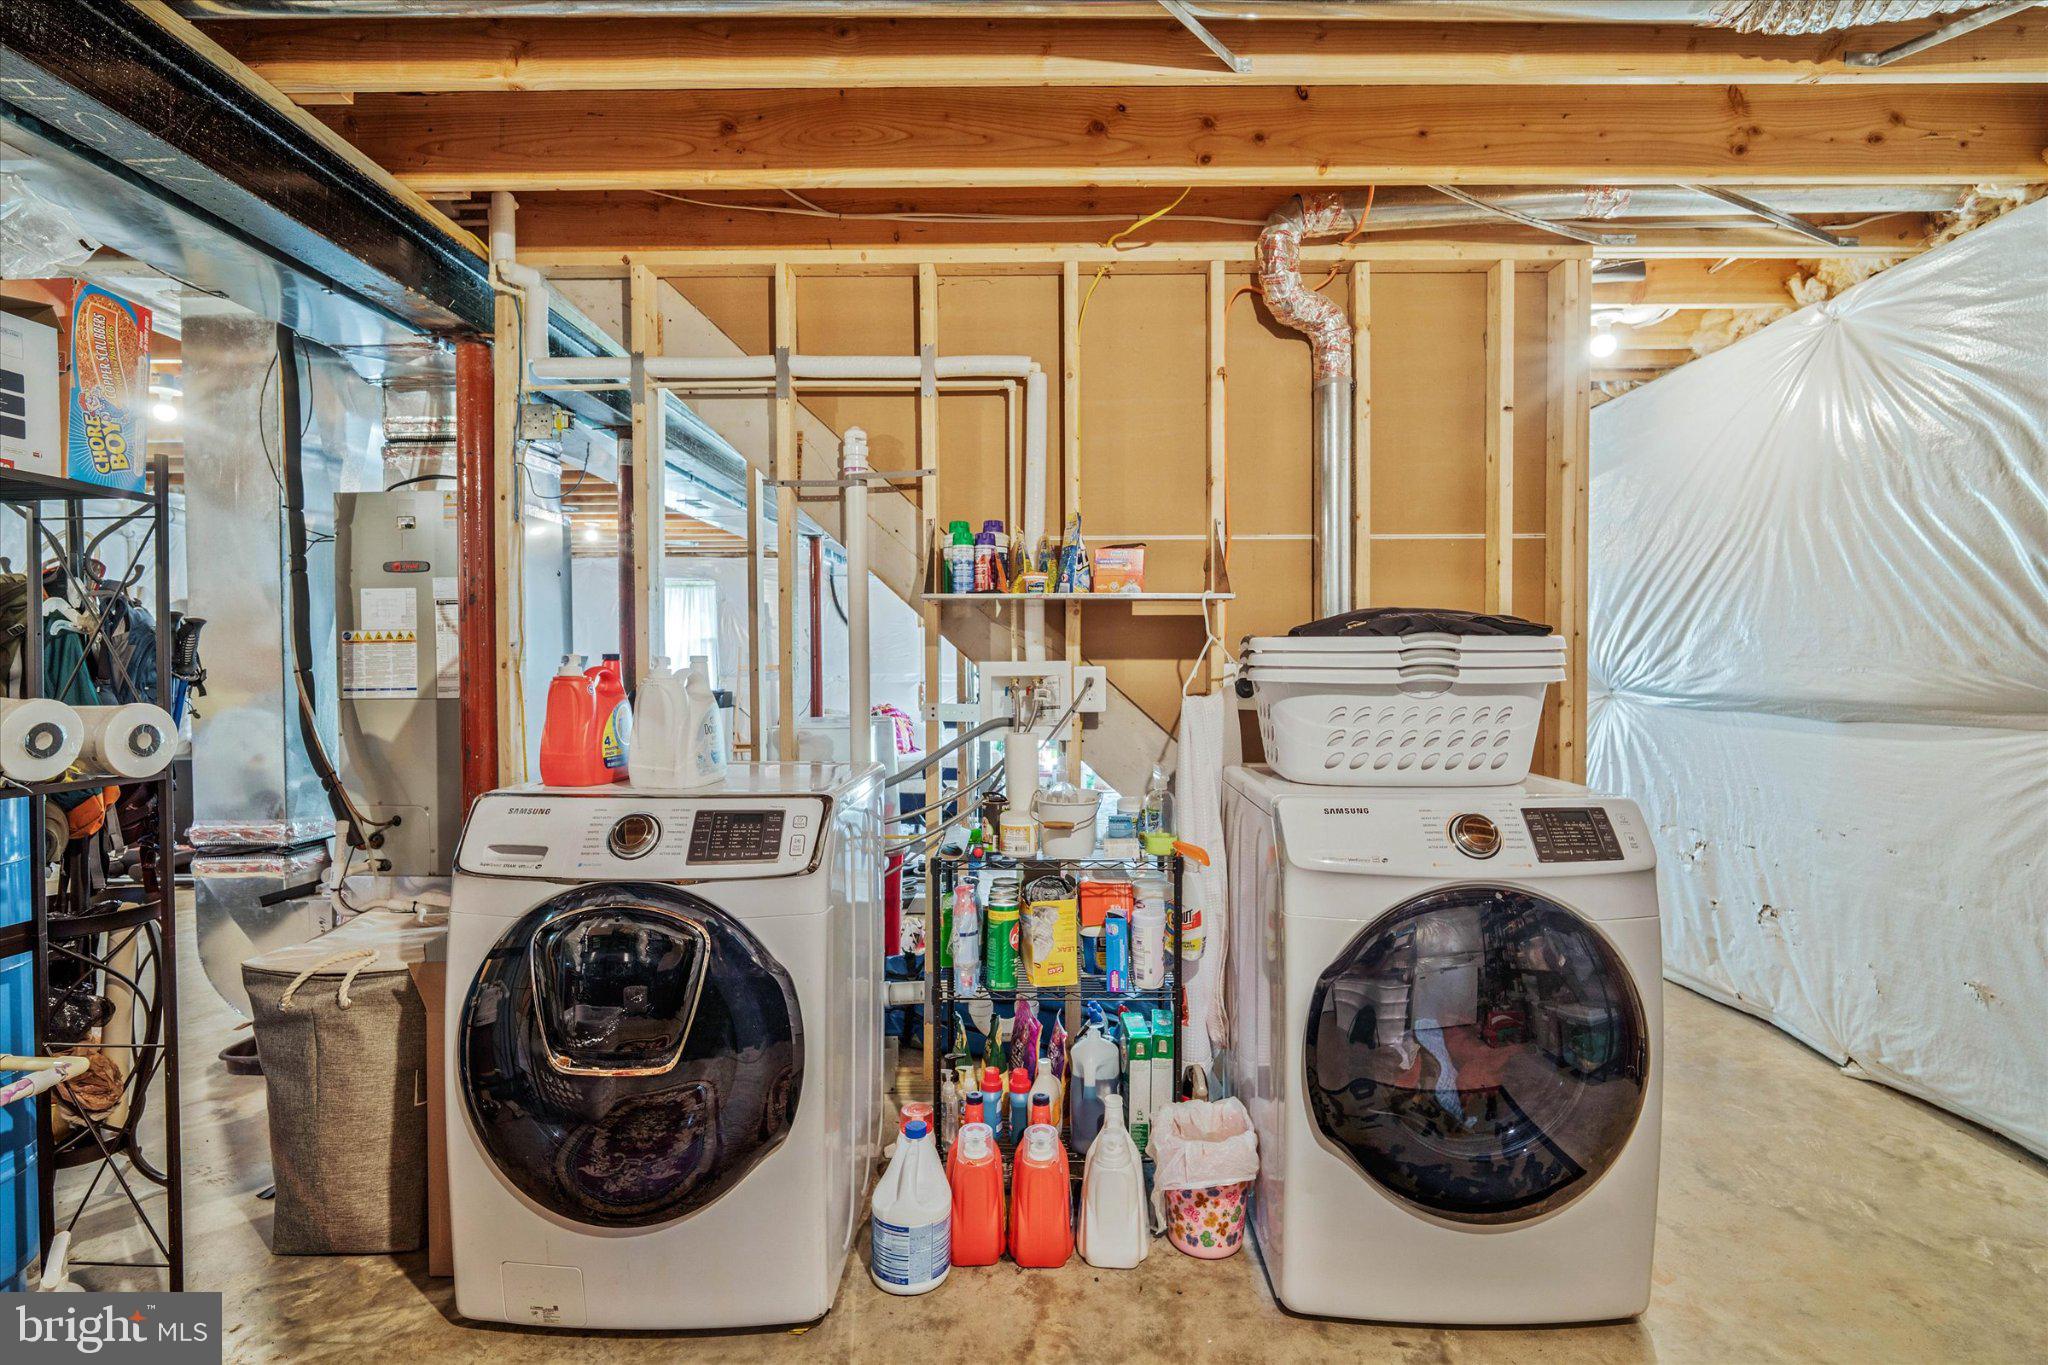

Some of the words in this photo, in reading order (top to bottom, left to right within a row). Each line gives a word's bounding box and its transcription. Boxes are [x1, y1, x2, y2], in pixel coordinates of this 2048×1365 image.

[93, 312, 110, 362] SCRUBBERS
[99, 361, 117, 399] COPPER
[83, 412, 111, 474] CHORE
[101, 418, 130, 471] BOY
[507, 807, 551, 815] SAMSUNG
[1323, 807, 1370, 815] SAMSUNG
